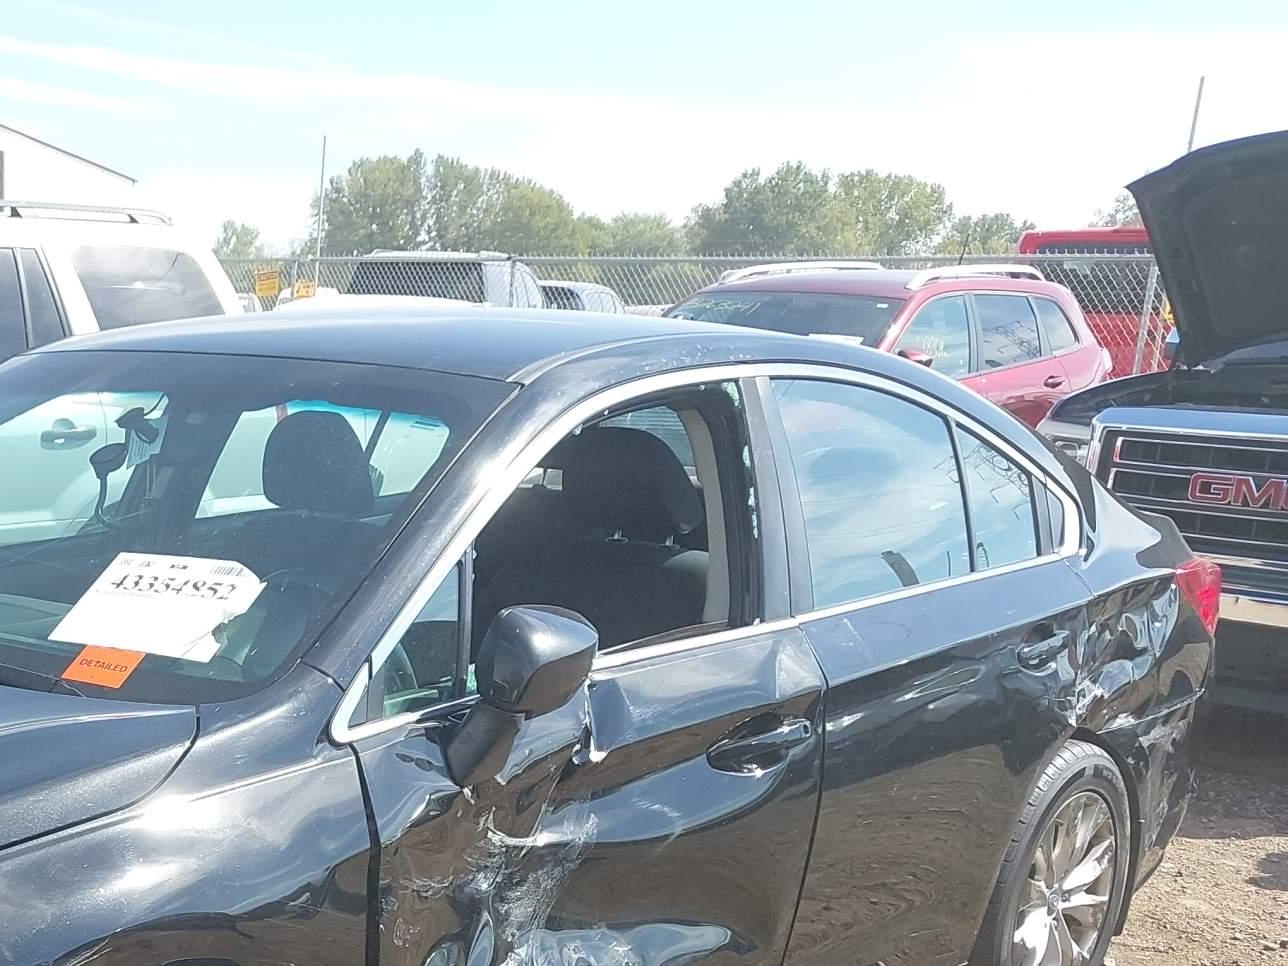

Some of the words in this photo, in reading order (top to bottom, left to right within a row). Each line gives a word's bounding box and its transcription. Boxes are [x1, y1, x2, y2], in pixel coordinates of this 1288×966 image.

[1188, 472, 1288, 510] GM
[112, 573, 237, 600] 43354852
[78, 657, 129, 674] DETAILED
